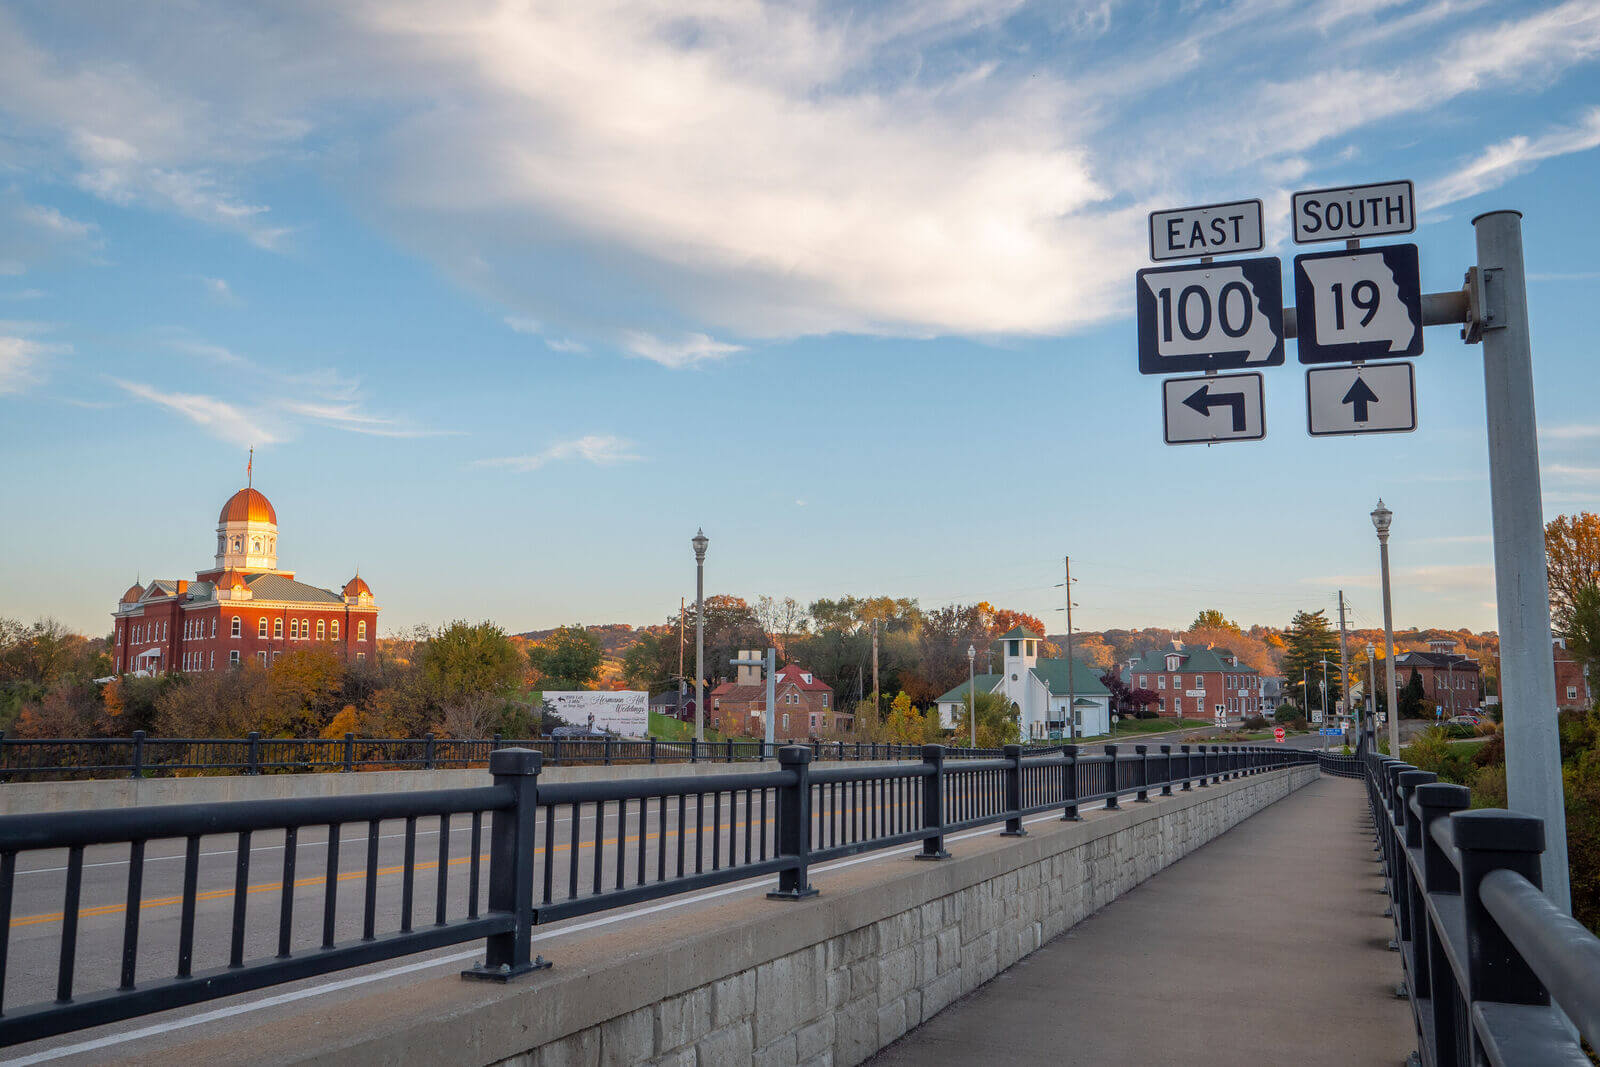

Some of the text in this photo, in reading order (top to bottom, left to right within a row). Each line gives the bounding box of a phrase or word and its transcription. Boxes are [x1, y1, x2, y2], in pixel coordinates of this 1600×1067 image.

[1167, 216, 1244, 250] EAST
[1302, 195, 1405, 233] SOUTH
[1158, 281, 1253, 342] 100
[1331, 280, 1380, 331] 19
